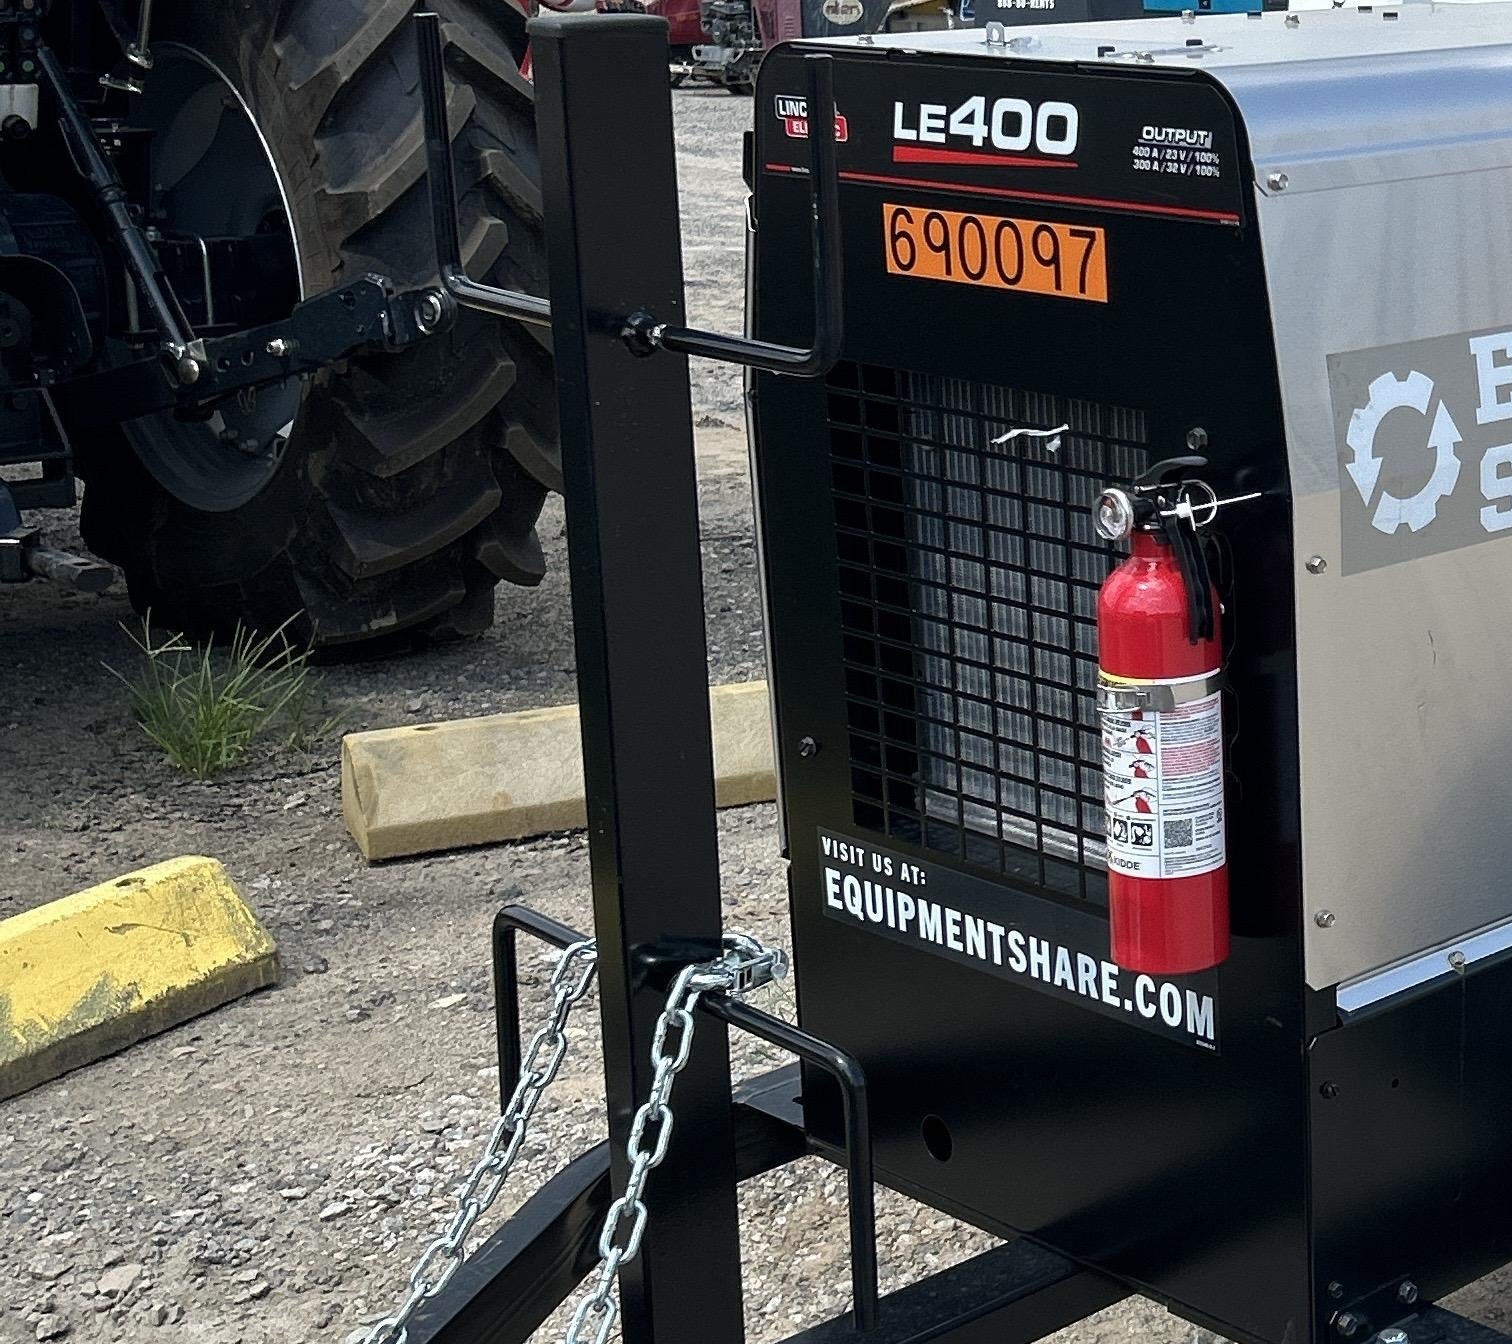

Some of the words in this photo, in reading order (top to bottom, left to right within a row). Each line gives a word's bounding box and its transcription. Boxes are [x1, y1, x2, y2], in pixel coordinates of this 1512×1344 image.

[778, 99, 808, 118] LINC
[893, 95, 1079, 156] LE400
[1142, 125, 1208, 145] OUTPUT
[1151, 149, 1159, 159] A
[1179, 150, 1187, 161] V
[1195, 152, 1220, 165] 100%
[1152, 160, 1159, 172] A
[1180, 163, 1187, 174] V
[1195, 165, 1220, 178] 100%
[889, 206, 1098, 294] 690097
[821, 836, 866, 868] VISIT
[871, 852, 894, 876] US
[899, 861, 927, 886] AT:
[824, 866, 1215, 1041] EQUIPMENTSHARE.COM
